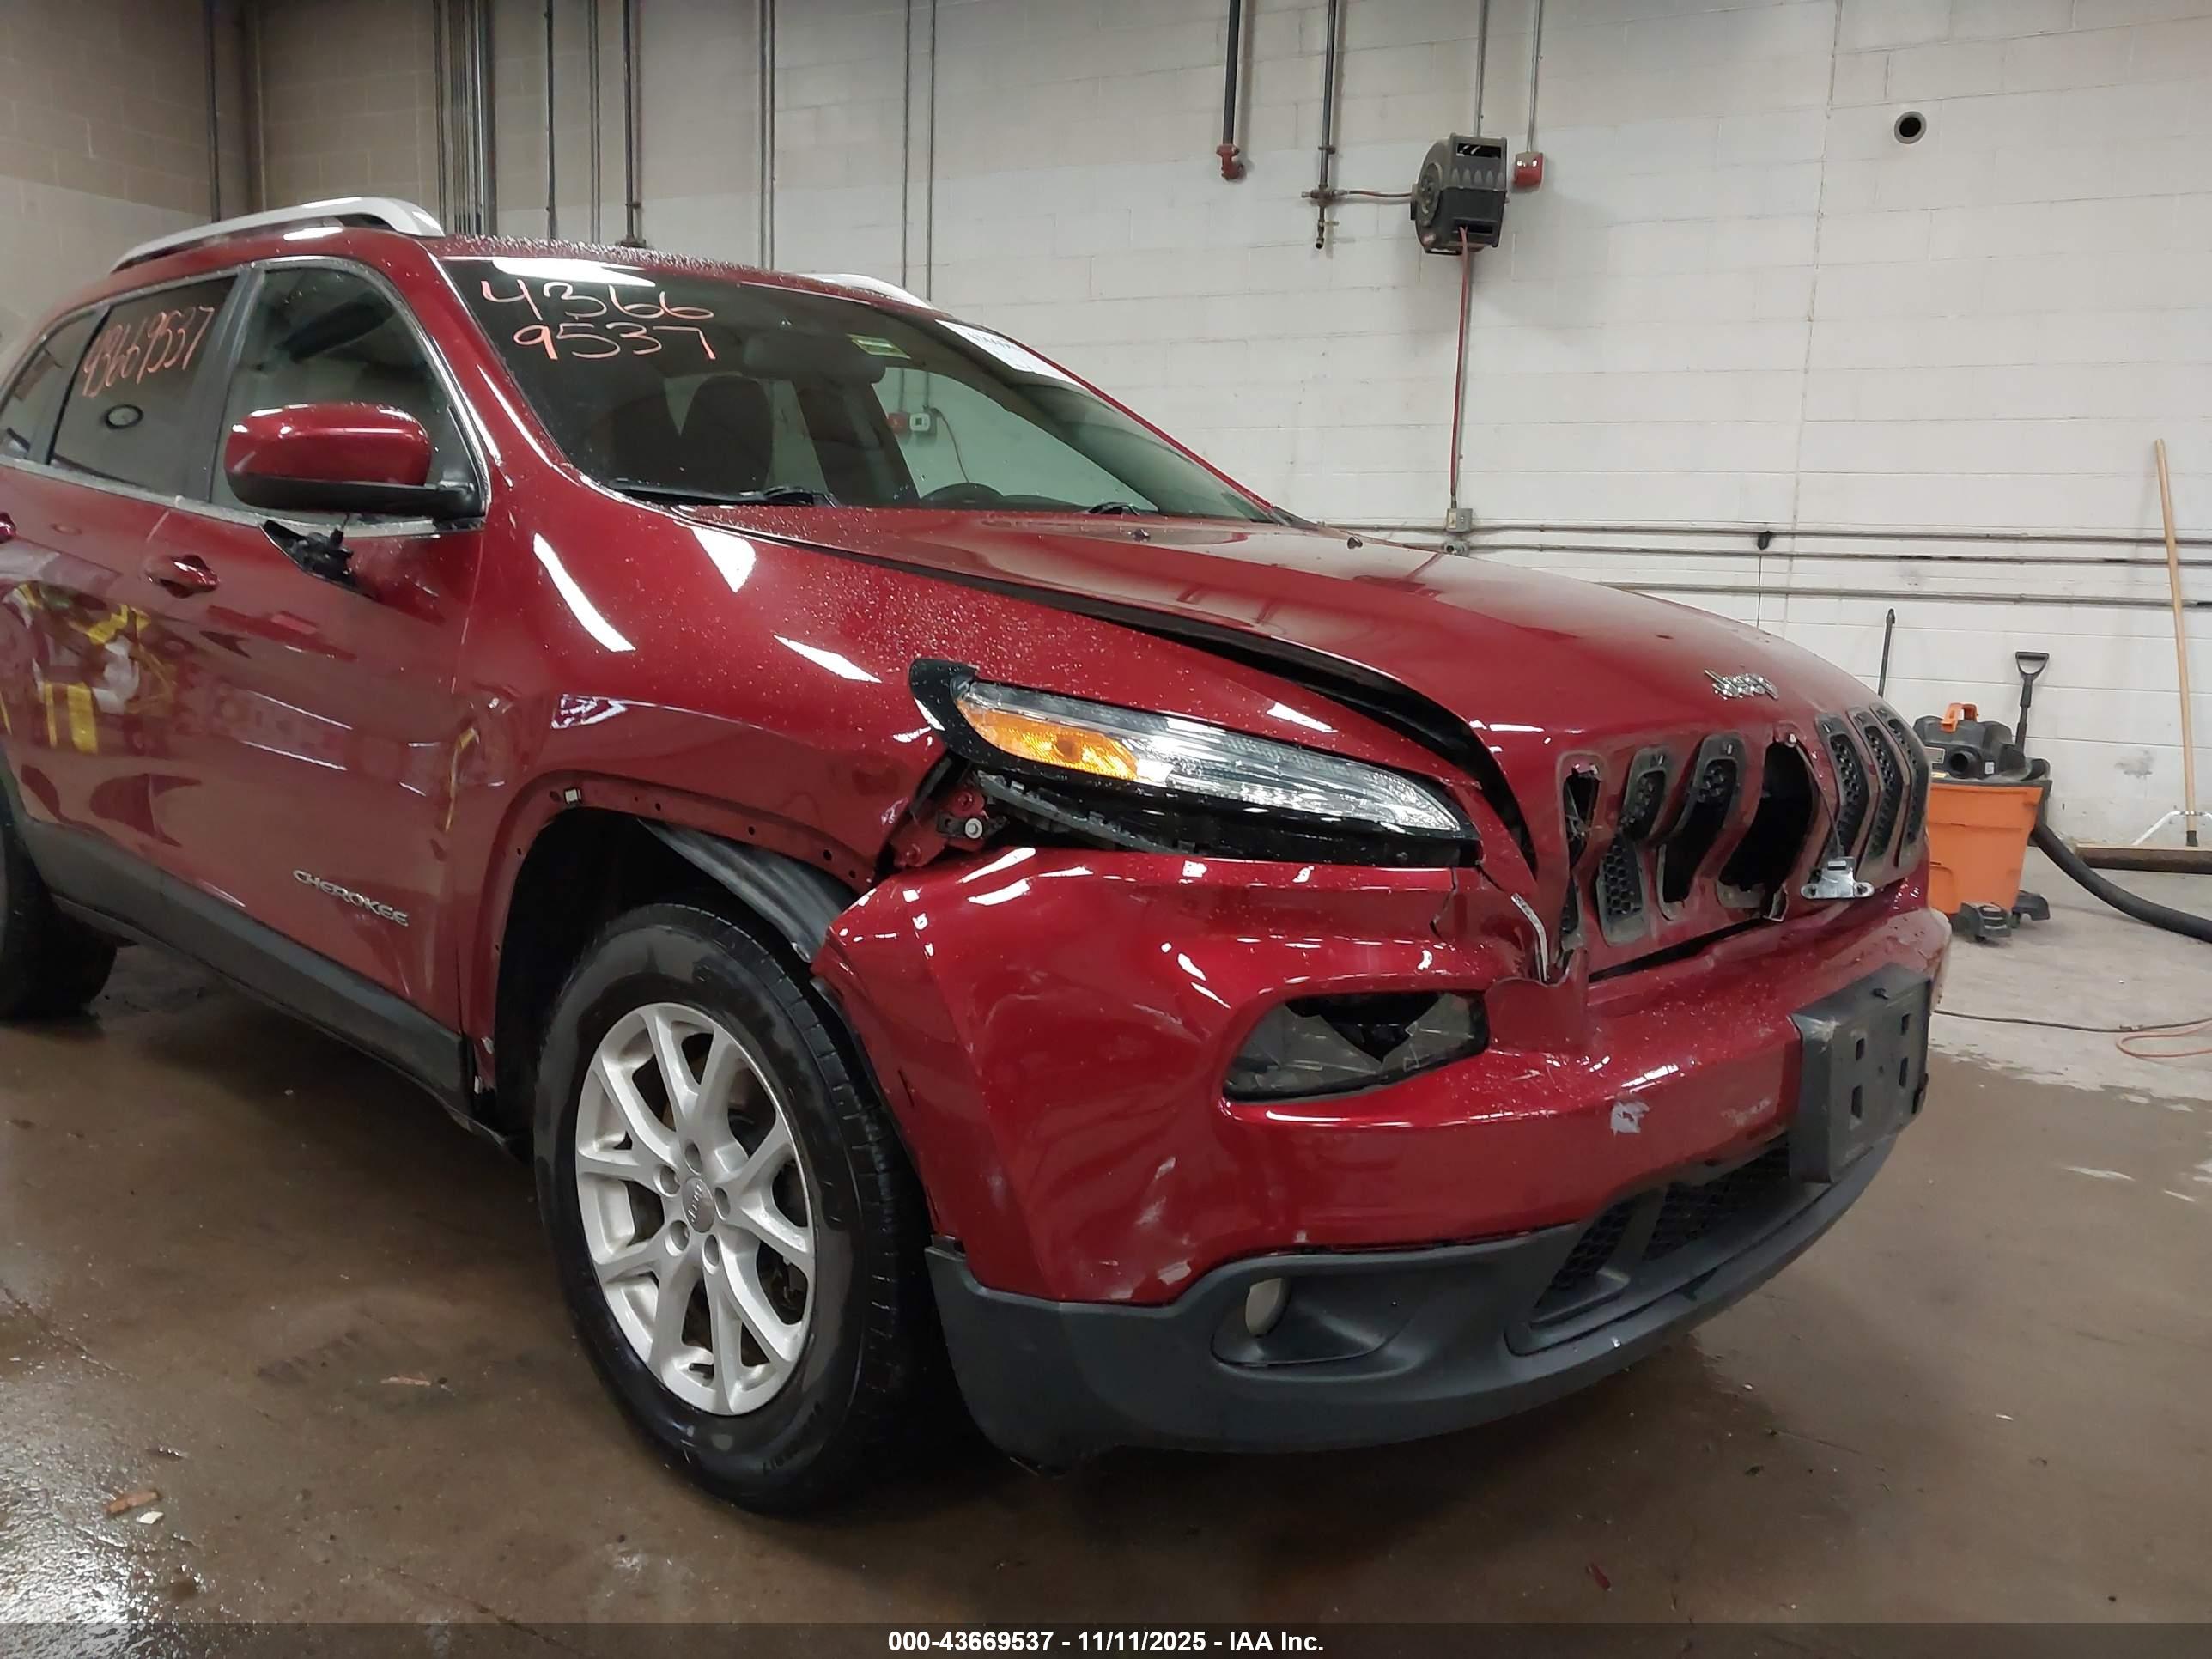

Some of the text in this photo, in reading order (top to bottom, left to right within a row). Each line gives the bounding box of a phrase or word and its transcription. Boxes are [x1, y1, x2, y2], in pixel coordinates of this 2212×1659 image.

[480, 279, 714, 320] 4366
[514, 322, 716, 360] 9537
[293, 869, 410, 927] CHEROKEE
